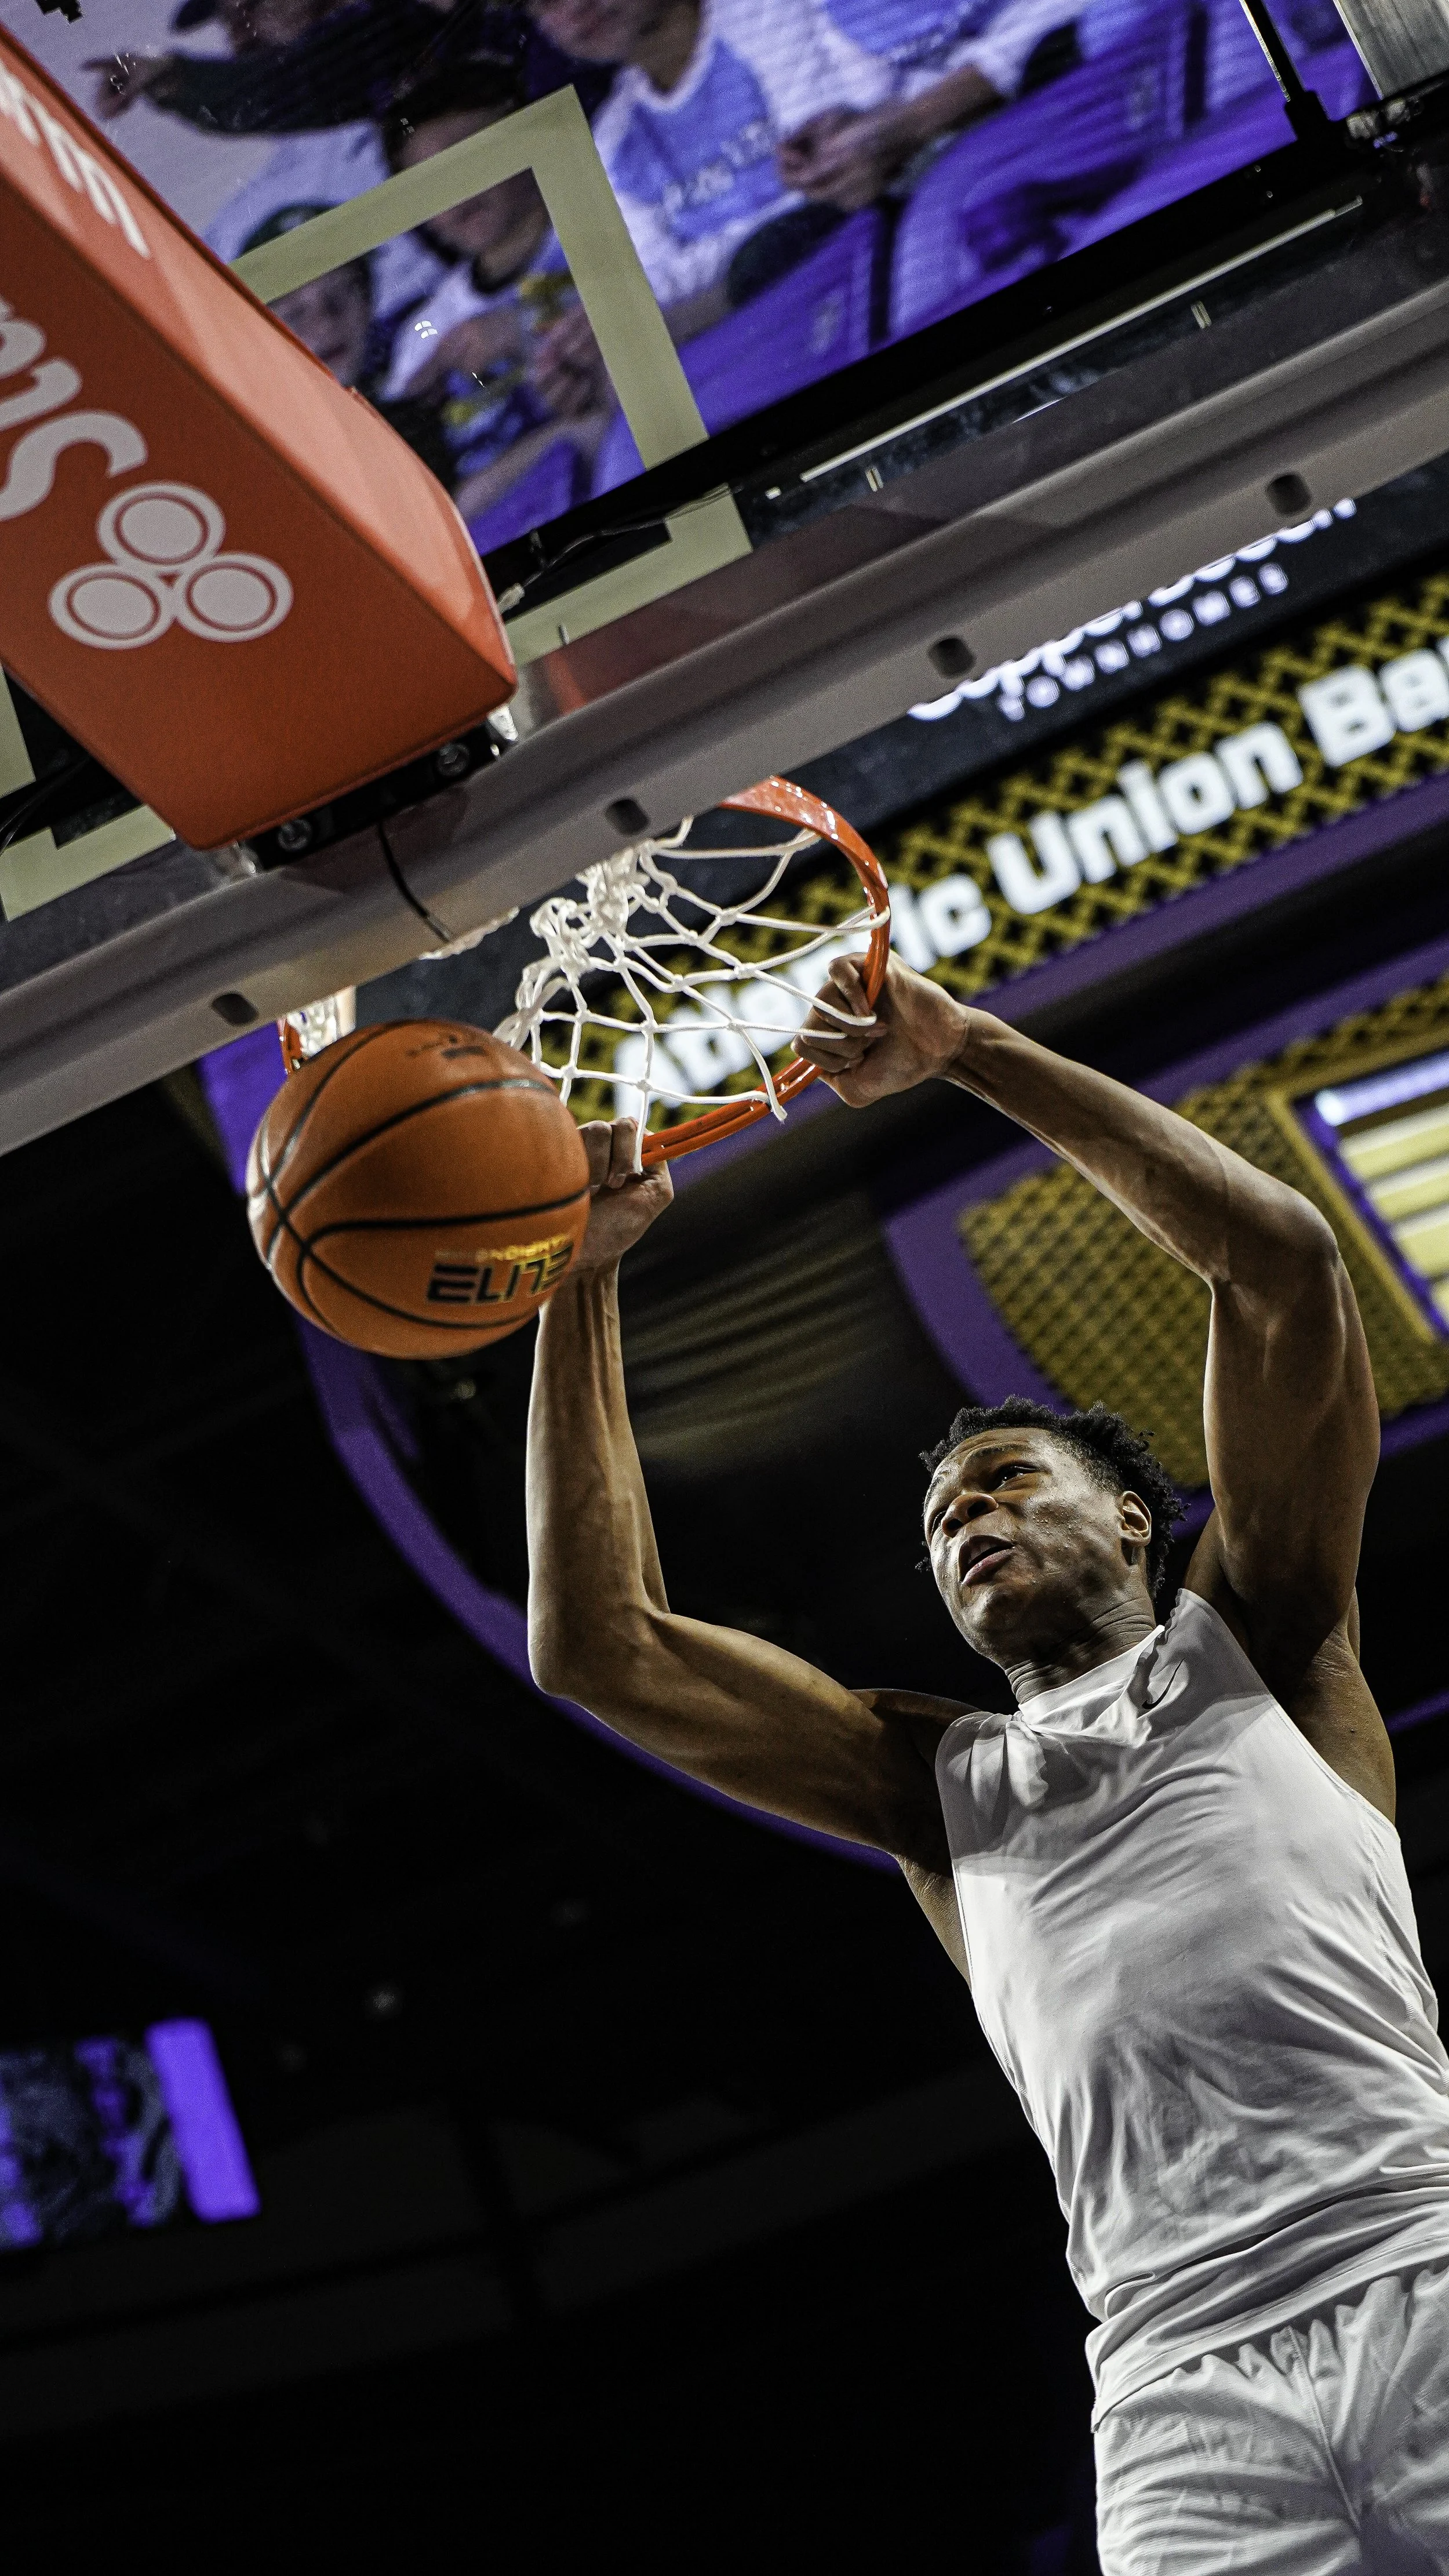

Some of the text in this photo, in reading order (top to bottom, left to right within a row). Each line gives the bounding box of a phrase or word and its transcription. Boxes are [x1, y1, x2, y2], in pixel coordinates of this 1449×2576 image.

[987, 721, 1304, 915] Union
[1296, 635, 1449, 768] Ba
[427, 1241, 574, 1302] ELITE
